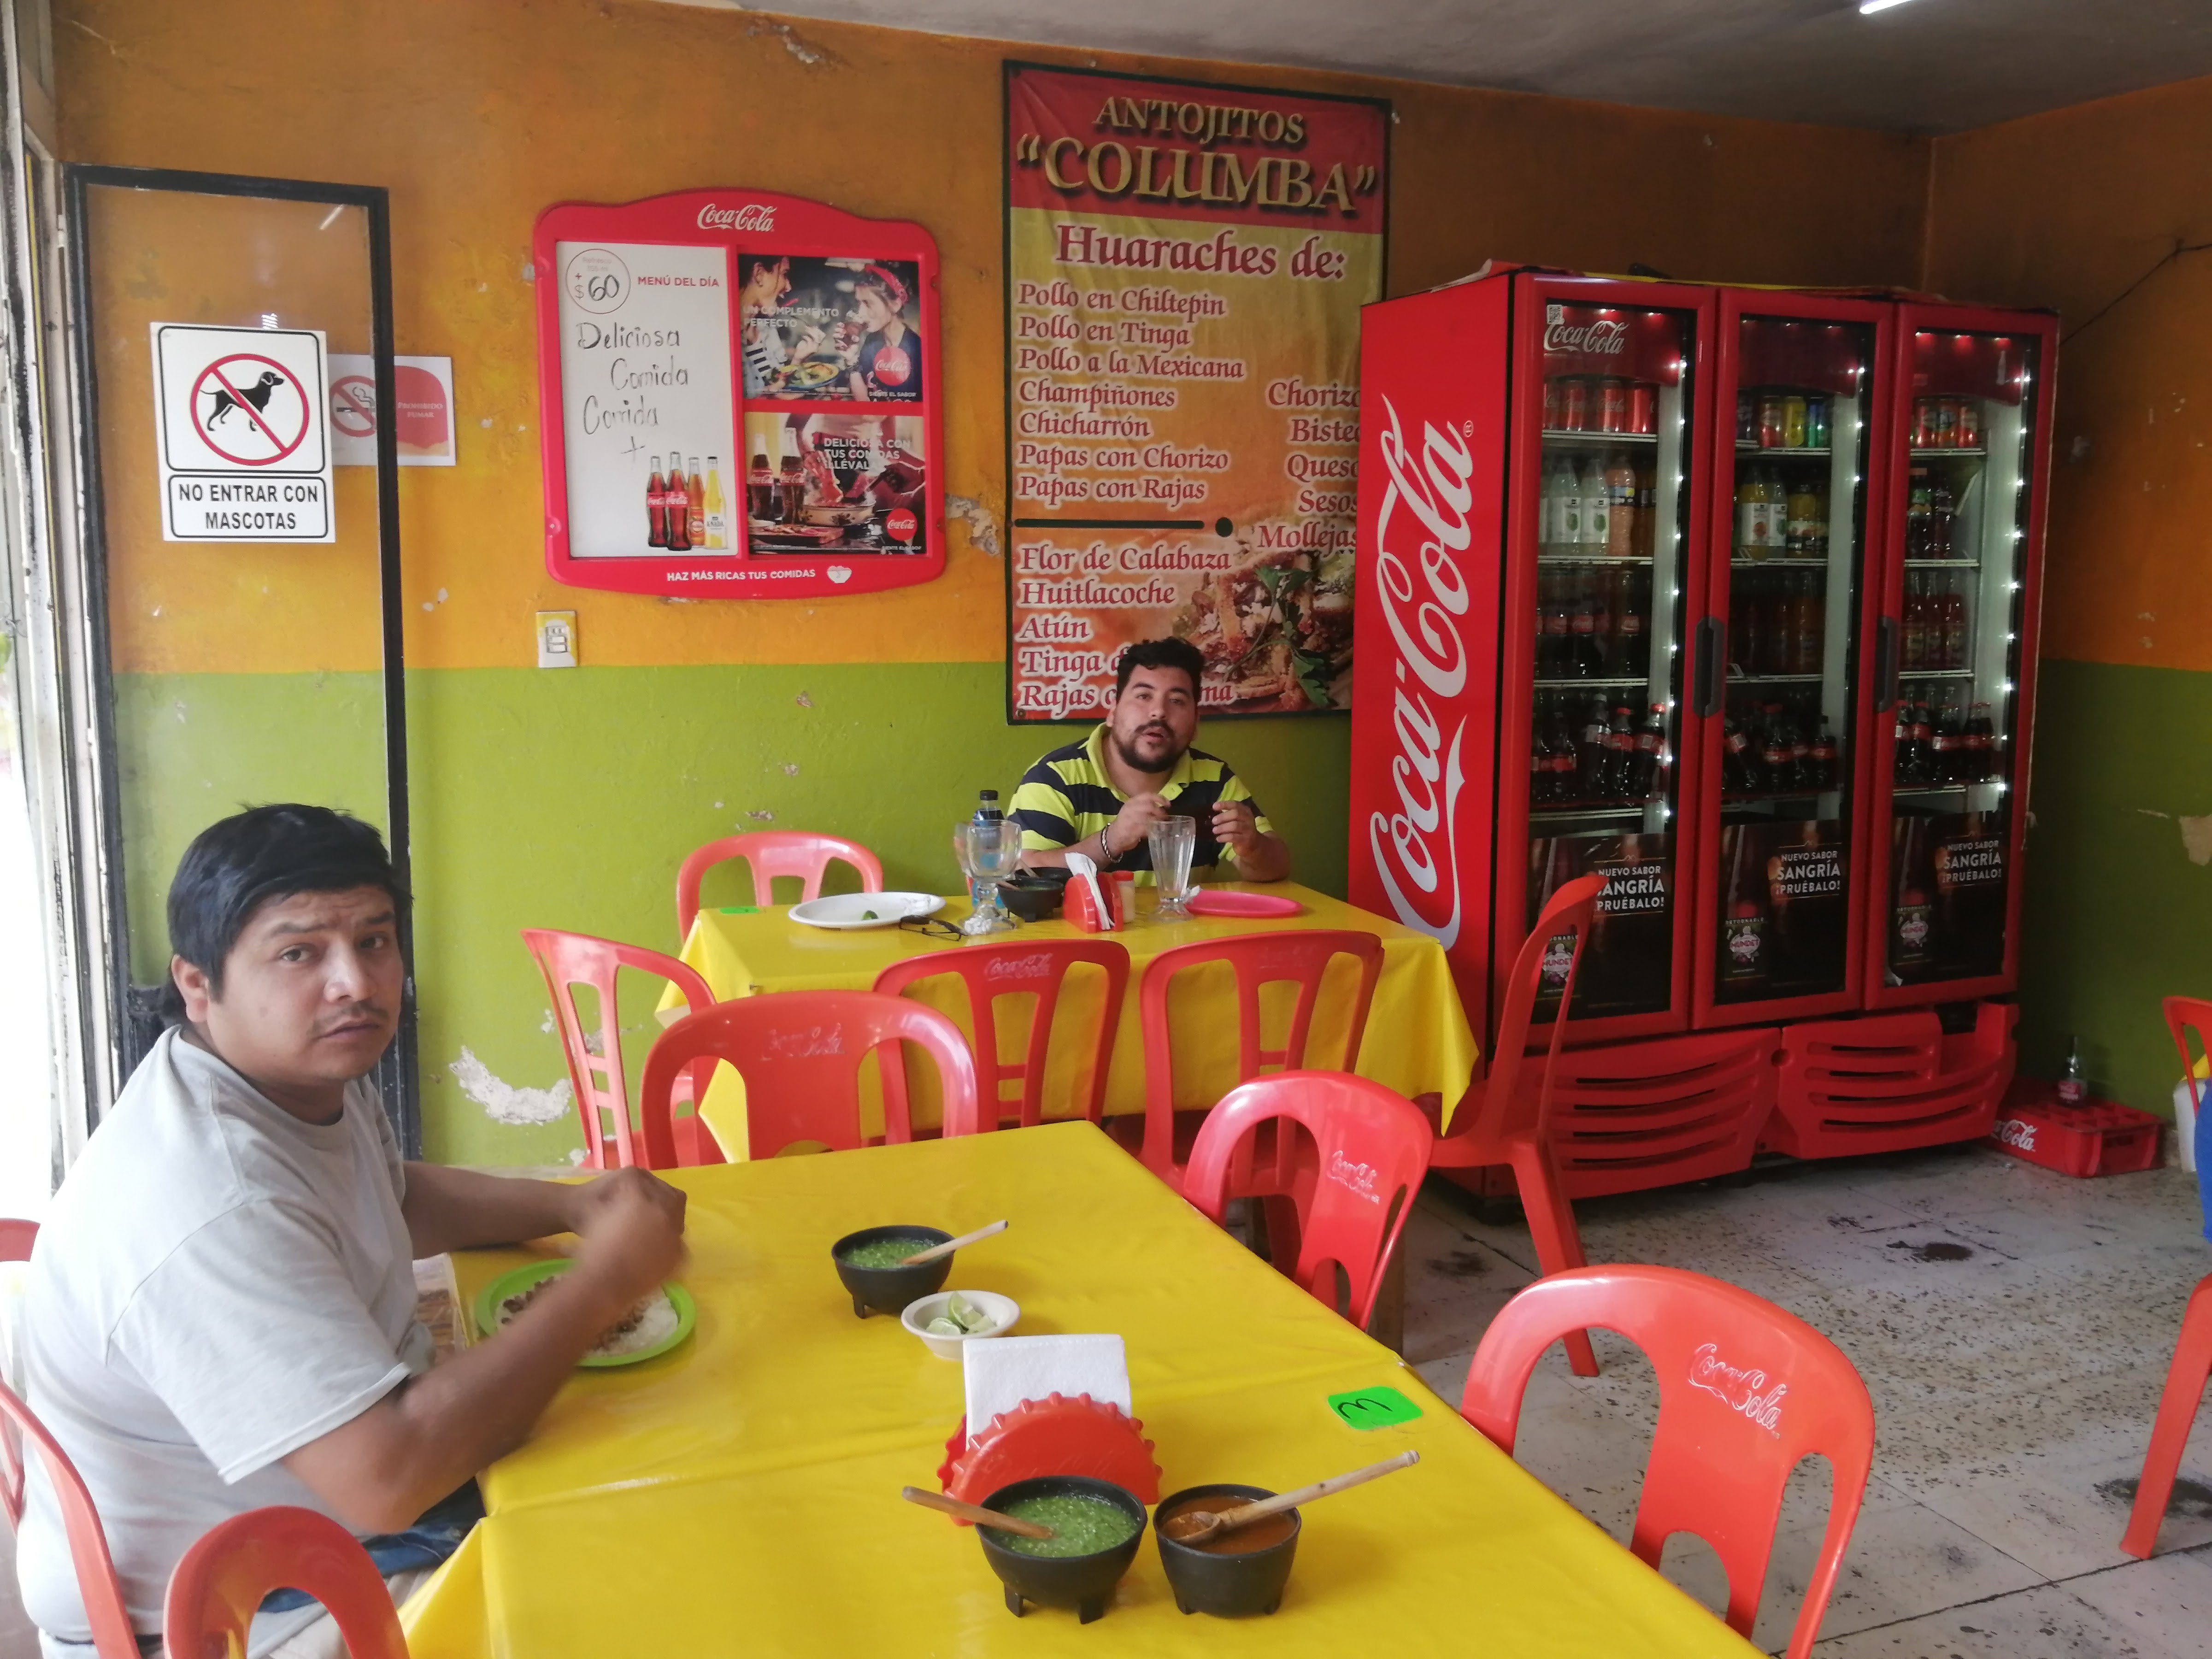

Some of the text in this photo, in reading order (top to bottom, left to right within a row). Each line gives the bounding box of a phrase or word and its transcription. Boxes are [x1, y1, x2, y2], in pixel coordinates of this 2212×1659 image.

[1092, 96, 1304, 144] ANTOJITOS
[1056, 225, 1345, 279] Huaraches de:
[638, 275, 719, 287] MENÚ DEL DÍA
[761, 306, 839, 317] COMPLEMENTO
[1018, 282, 1225, 323] Pollo en Chiltepin
[576, 322, 680, 349] Deliciosa
[1018, 317, 1190, 352] Pollo en Tinga
[1544, 320, 1630, 354] Coca-Cola
[1018, 349, 1243, 377] Pollo a la Mexicana
[1020, 382, 1174, 412] Champiñones
[1020, 413, 1149, 436] Chicharrón
[824, 437, 883, 448] DELICIOA
[824, 449, 900, 460] TUS CODAS
[1020, 445, 1229, 473] Papas con Chorizo
[180, 484, 318, 502] NO ENTRAR CON
[1020, 477, 1205, 506] Papas con Rajas
[206, 513, 295, 529] MASCOTAS
[1021, 546, 1231, 571] Flor de Calabaza
[667, 569, 816, 581] HAZ MÁS RICAS TUS COMIDAS
[1021, 579, 1175, 605] Huitlacoche
[1019, 616, 1088, 639] Atún
[1022, 649, 1102, 682] Tinga
[1370, 393, 1474, 952] Coca-Cola
[1021, 685, 1095, 715] Rajas
[1781, 851, 1837, 862] NUEVO SABOR
[1943, 850, 2001, 870] SANGRÍA
[1599, 866, 1661, 876] NUEVO SABOR
[1777, 860, 1841, 882] SANGRÍA
[1597, 876, 1665, 896] ANGRÍA
[1596, 897, 1665, 911] PRUÉBALO!
[1688, 1343, 1787, 1430] Coca-Cola
